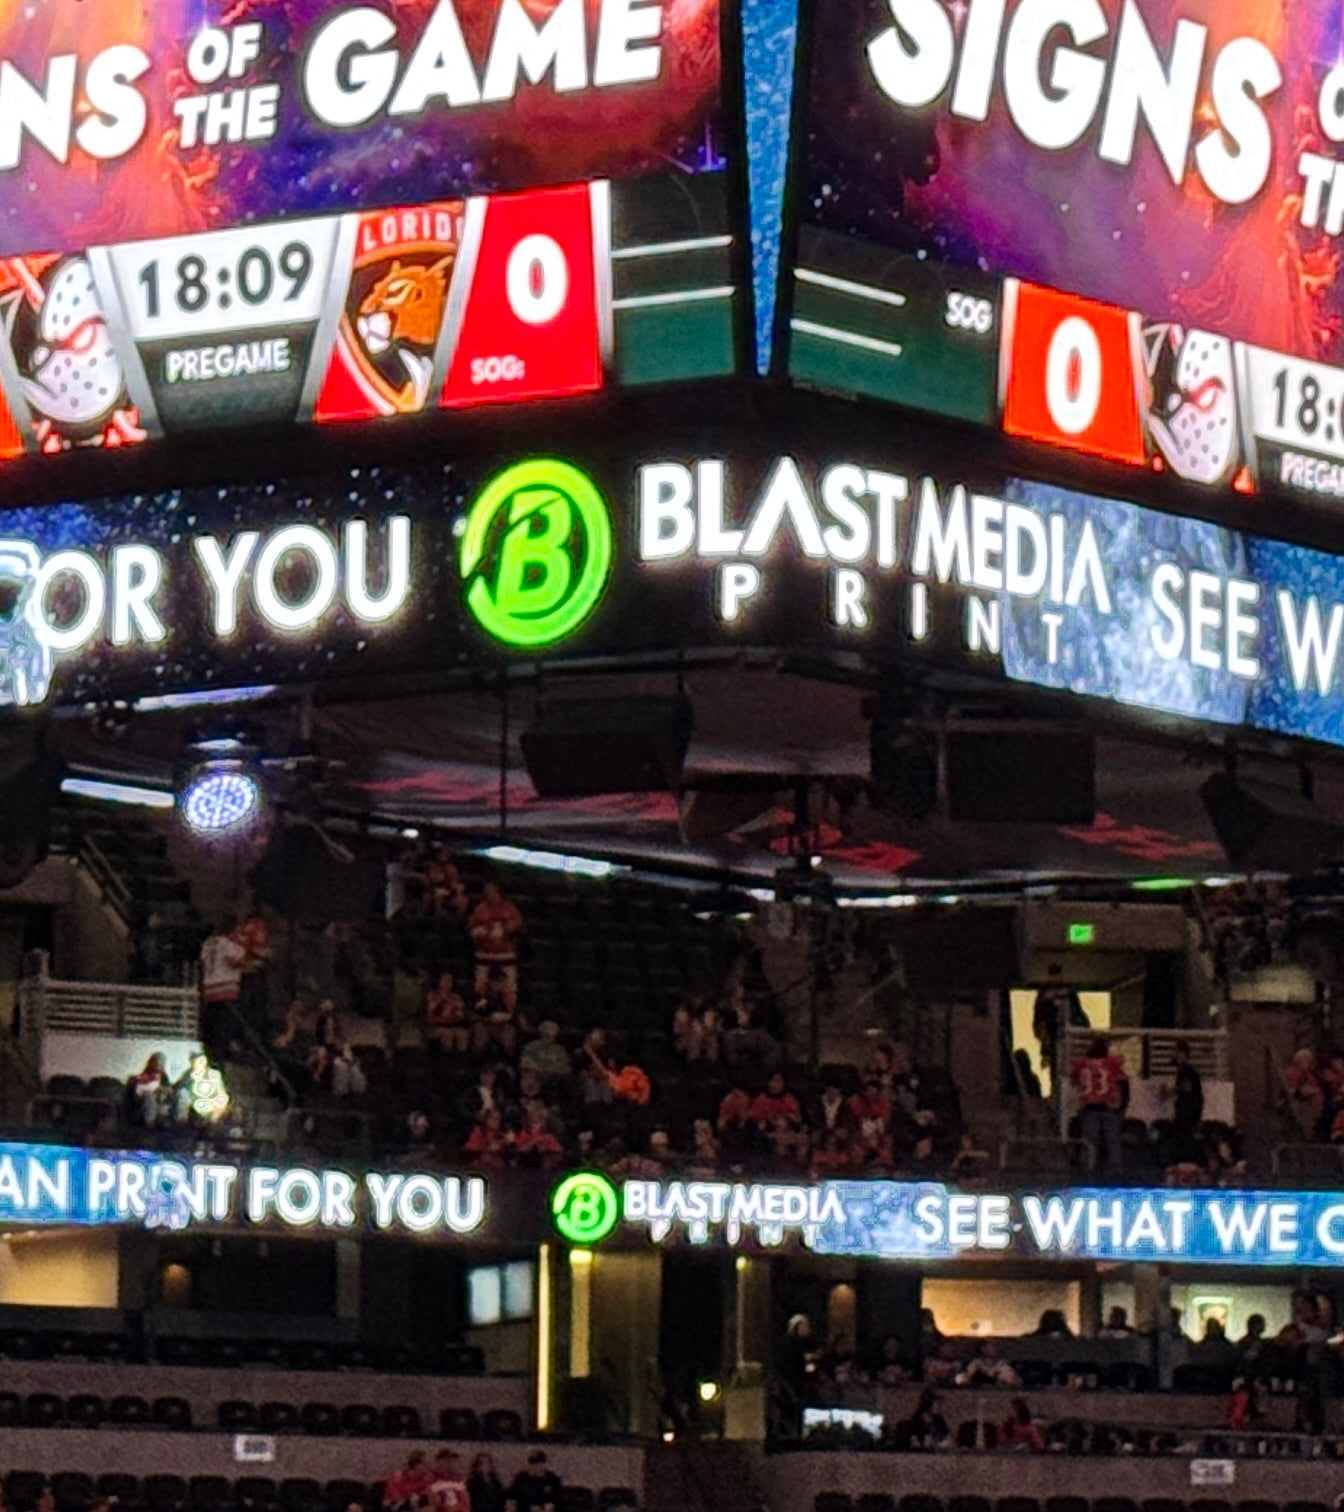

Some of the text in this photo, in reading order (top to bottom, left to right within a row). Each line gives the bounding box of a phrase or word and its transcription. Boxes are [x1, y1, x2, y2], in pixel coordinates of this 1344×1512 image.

[186, 22, 264, 85] OF
[174, 89, 278, 151] THE
[137, 240, 314, 319] 18:09
[506, 233, 569, 325] 0
[945, 291, 993, 334] SOG
[167, 337, 291, 383] PREGAME
[1045, 315, 1102, 435] 0
[640, 455, 1110, 614] BLAST MEDIA
[22, 542, 168, 654] OR
[195, 518, 410, 635] YOU
[720, 563, 1062, 664] PRINT
[1152, 560, 1260, 679] SEE
[248, 1166, 355, 1227] FOR
[365, 1173, 487, 1233] YOU
[624, 1180, 847, 1225] BLAST MEDIA
[913, 1194, 1009, 1248] SEE
[1022, 1196, 1192, 1253] WHAT
[1207, 1202, 1298, 1252] WE
